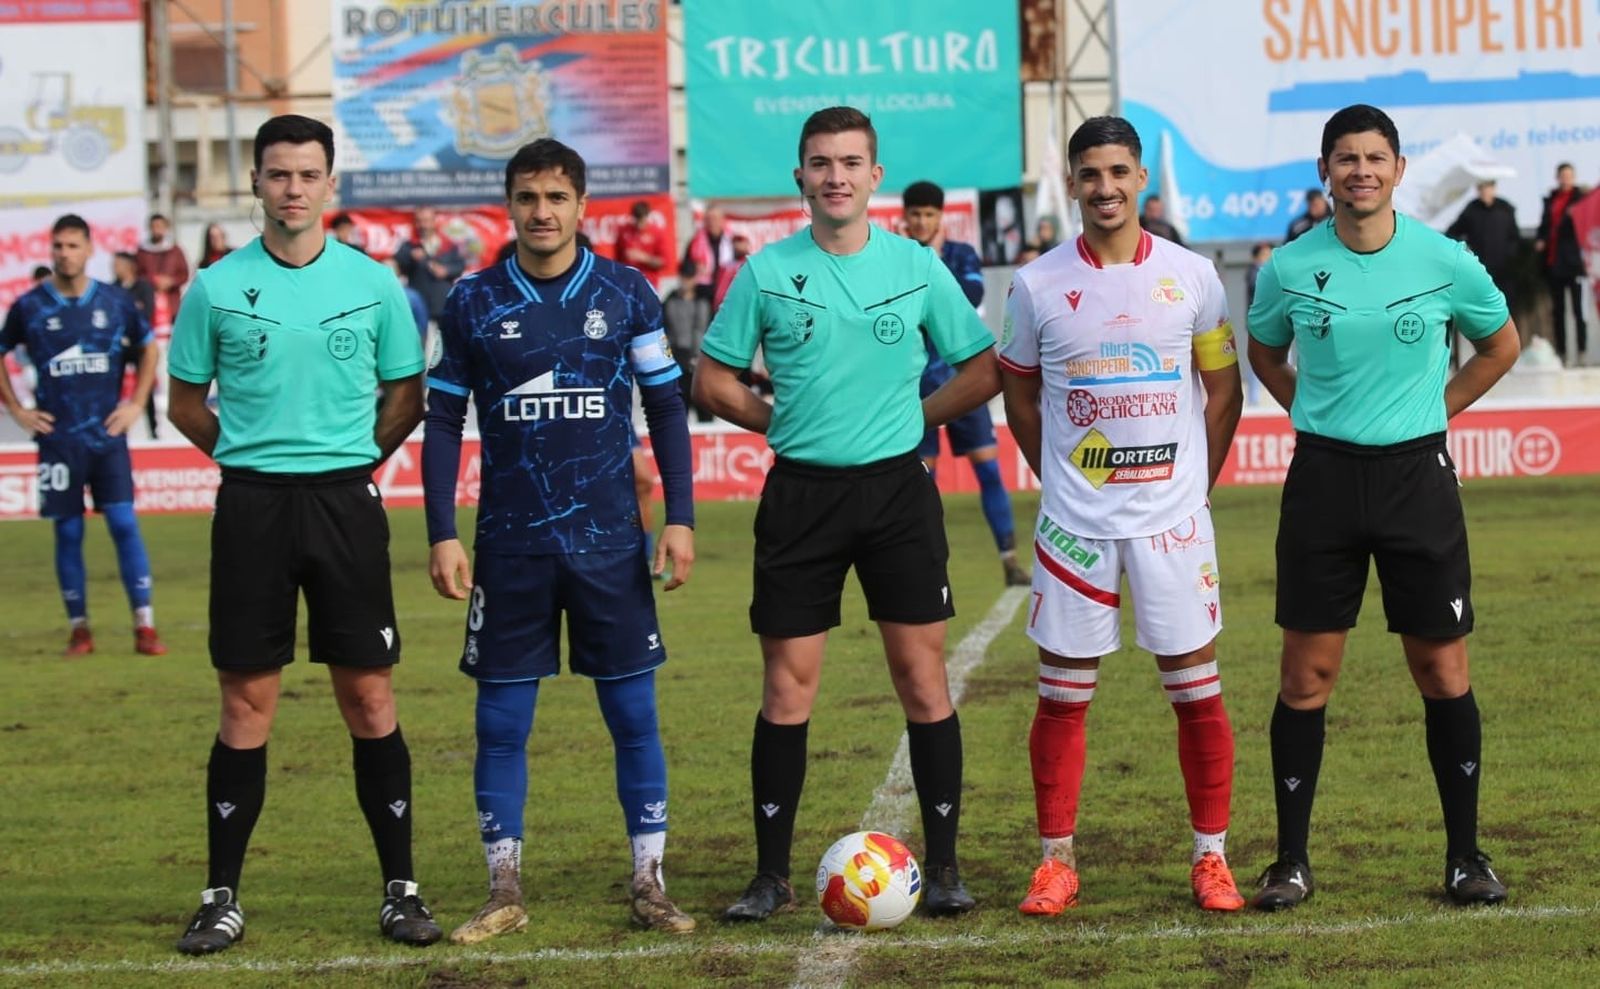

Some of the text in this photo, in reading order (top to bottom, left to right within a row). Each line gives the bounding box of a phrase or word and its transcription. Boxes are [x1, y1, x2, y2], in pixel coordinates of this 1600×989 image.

[342, 3, 661, 37] ROTUHERCULES
[845, 93, 869, 111] DE
[876, 93, 955, 111] LOCURA
[1221, 190, 1278, 218] 409
[48, 358, 110, 378] LOTUS
[1065, 357, 1130, 376] SANCTIPETRI
[503, 395, 605, 421] LOTUS
[1098, 391, 1177, 406] RODAMIENTOS
[1098, 402, 1177, 419] CHICLANA
[1111, 447, 1171, 465] ORTEGA
[38, 462, 70, 491] 20
[1039, 515, 1101, 570] Vidal
[1030, 592, 1043, 628] 7
